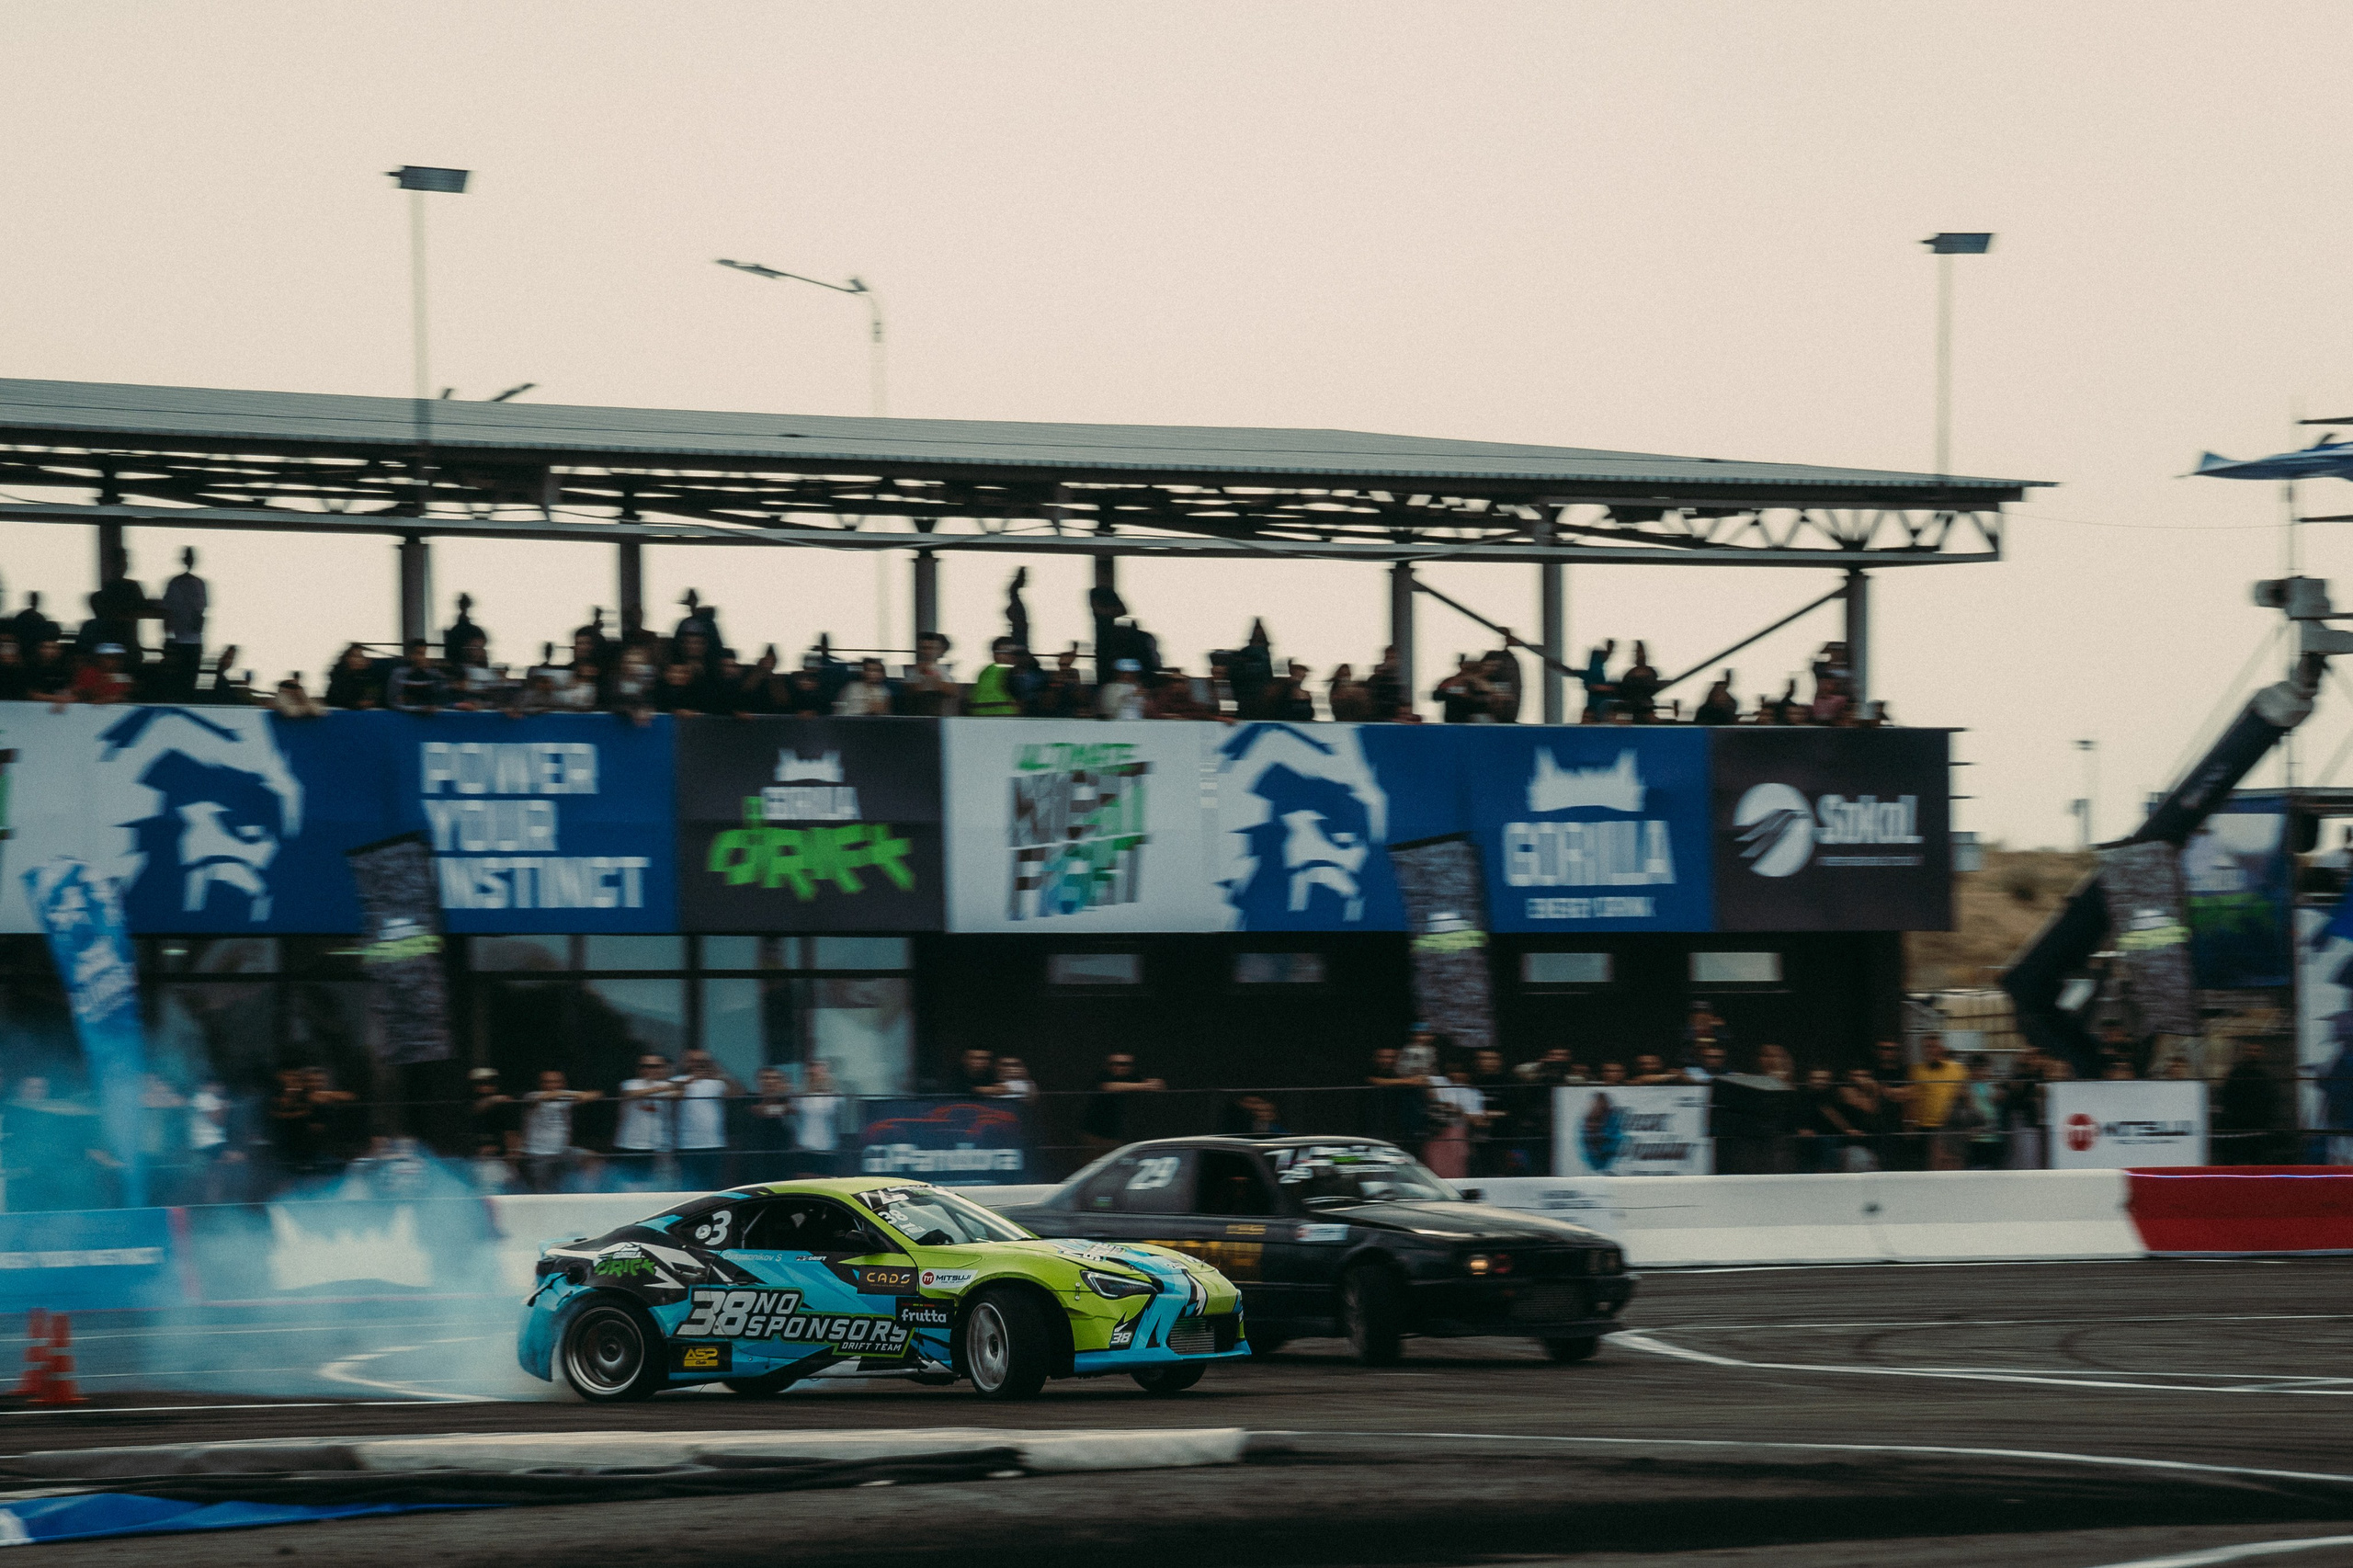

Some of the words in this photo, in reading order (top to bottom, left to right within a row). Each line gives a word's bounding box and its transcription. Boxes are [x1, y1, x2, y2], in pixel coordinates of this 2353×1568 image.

[420, 742, 599, 794] POWER
[420, 799, 559, 851] YOUR
[1503, 821, 1676, 886] GORILLA
[434, 856, 652, 909] NSTINCT
[878, 1209, 909, 1224] 38
[775, 1254, 782, 1262] S
[676, 1290, 757, 1335] 38
[752, 1292, 799, 1314] NO
[902, 1308, 947, 1324] frutta
[745, 1315, 907, 1343] SPONSORS
[1110, 1332, 1132, 1344] 38
[685, 1347, 718, 1359] ASP
[841, 1342, 871, 1350] DRIFT
[874, 1343, 903, 1352] TEAM
